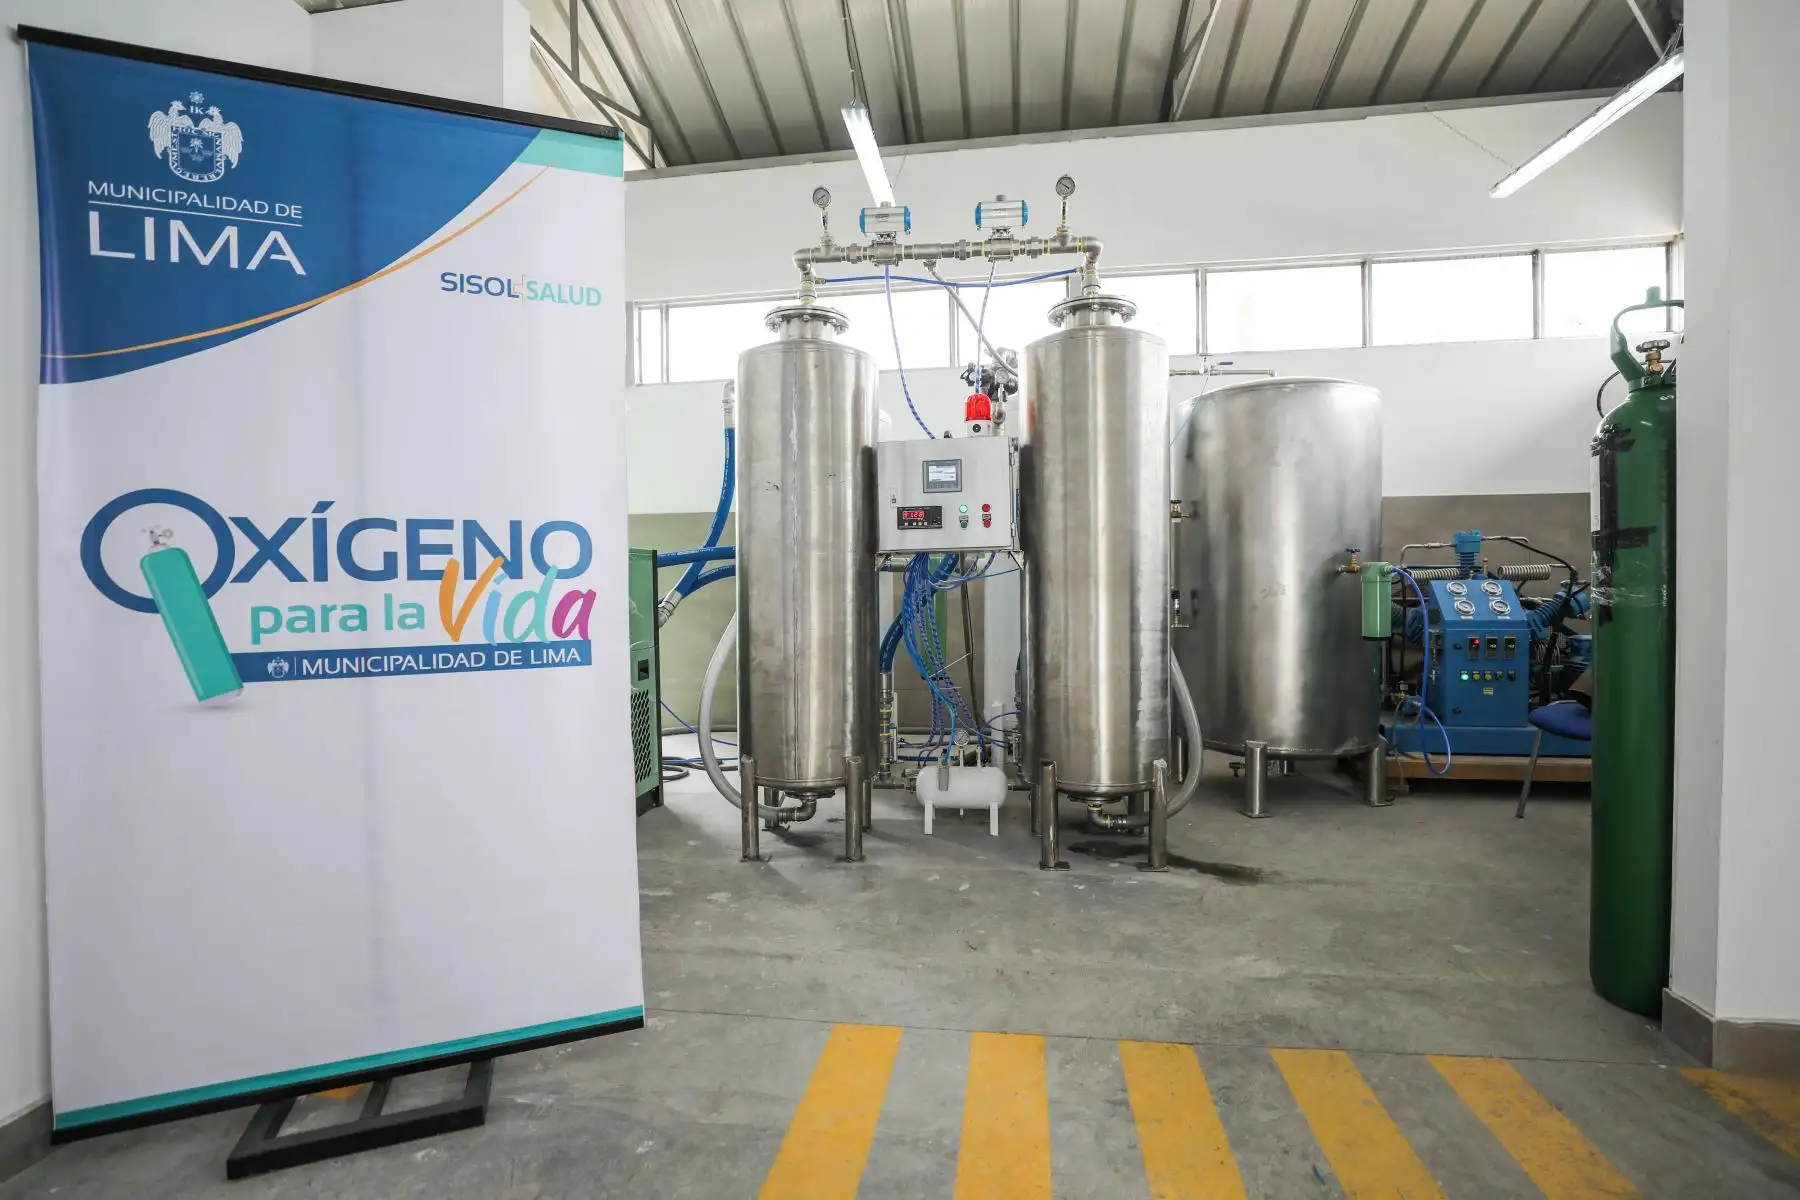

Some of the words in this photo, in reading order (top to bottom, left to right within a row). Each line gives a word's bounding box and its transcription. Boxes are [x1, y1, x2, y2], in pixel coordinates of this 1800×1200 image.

[189, 105, 204, 115] IK
[88, 181, 269, 215] MUNICIPALIDAD
[275, 203, 303, 219] DE
[89, 211, 306, 276] LIMA
[440, 272, 520, 299] SISOL
[526, 279, 602, 307] SALUD
[80, 488, 593, 613] OXÍGENO
[250, 603, 368, 646] para
[384, 593, 426, 631] la
[439, 556, 597, 646] Vida
[302, 651, 487, 677] MUNICIPALIDAD
[494, 649, 523, 666] DE
[530, 646, 582, 664] LIMA
